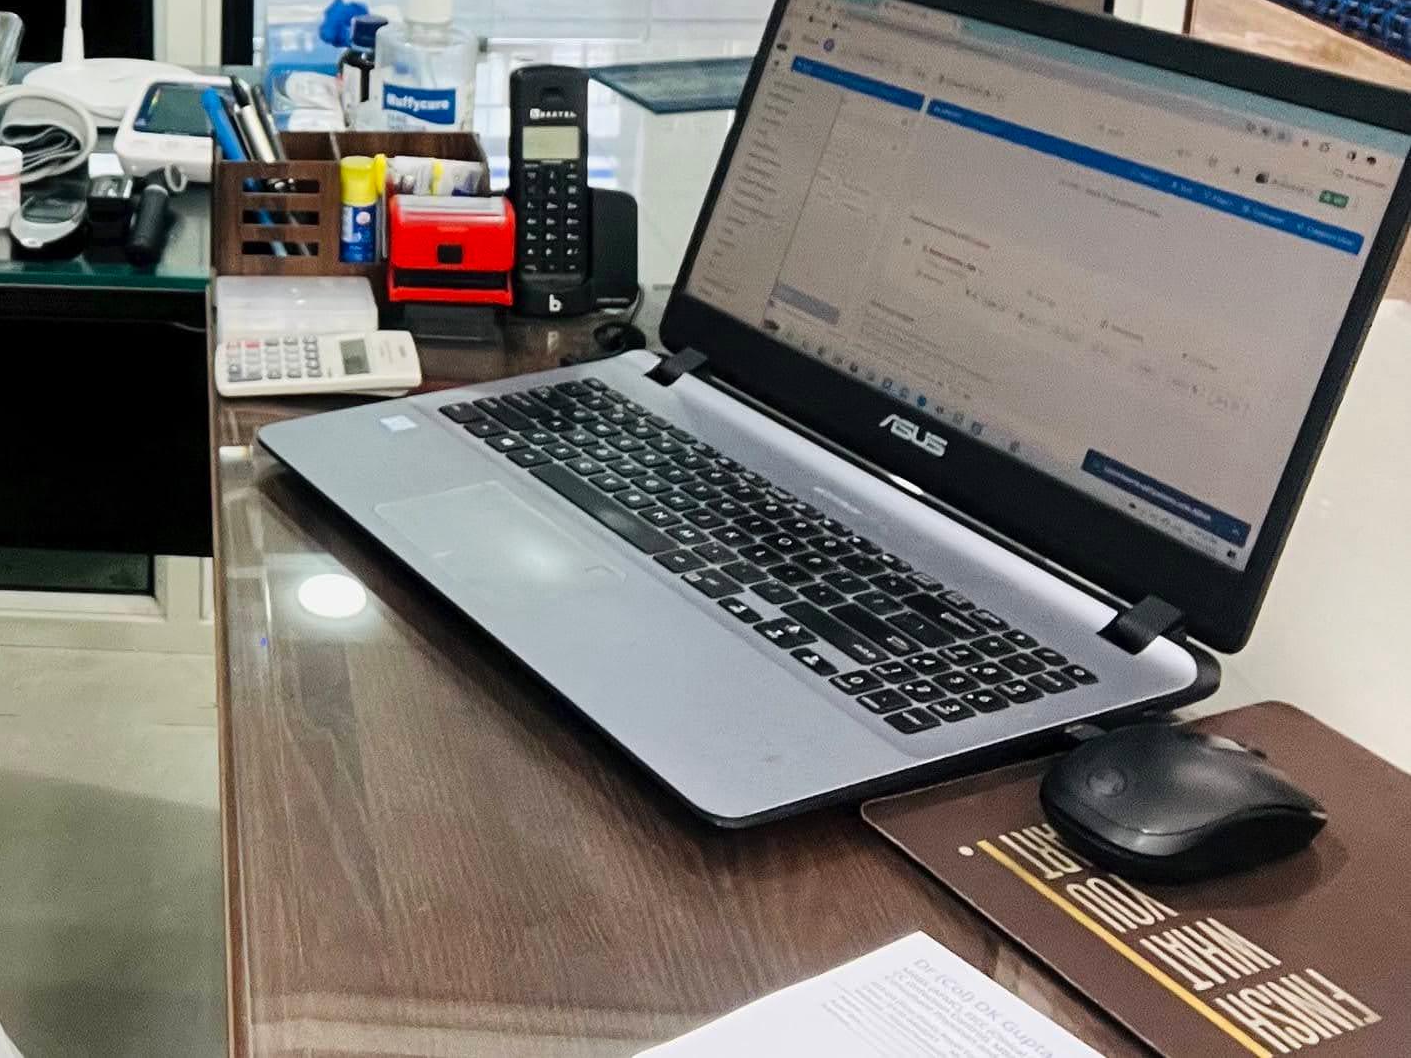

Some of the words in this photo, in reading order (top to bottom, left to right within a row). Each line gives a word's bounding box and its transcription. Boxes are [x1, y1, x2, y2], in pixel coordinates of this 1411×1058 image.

[879, 414, 948, 457] ASUS
[998, 823, 1097, 880] ART
[1065, 872, 1180, 934] YOU
[1139, 916, 1282, 992] WHAT
[975, 1000, 1003, 1022] DK
[1213, 968, 1383, 1055] FINISH
